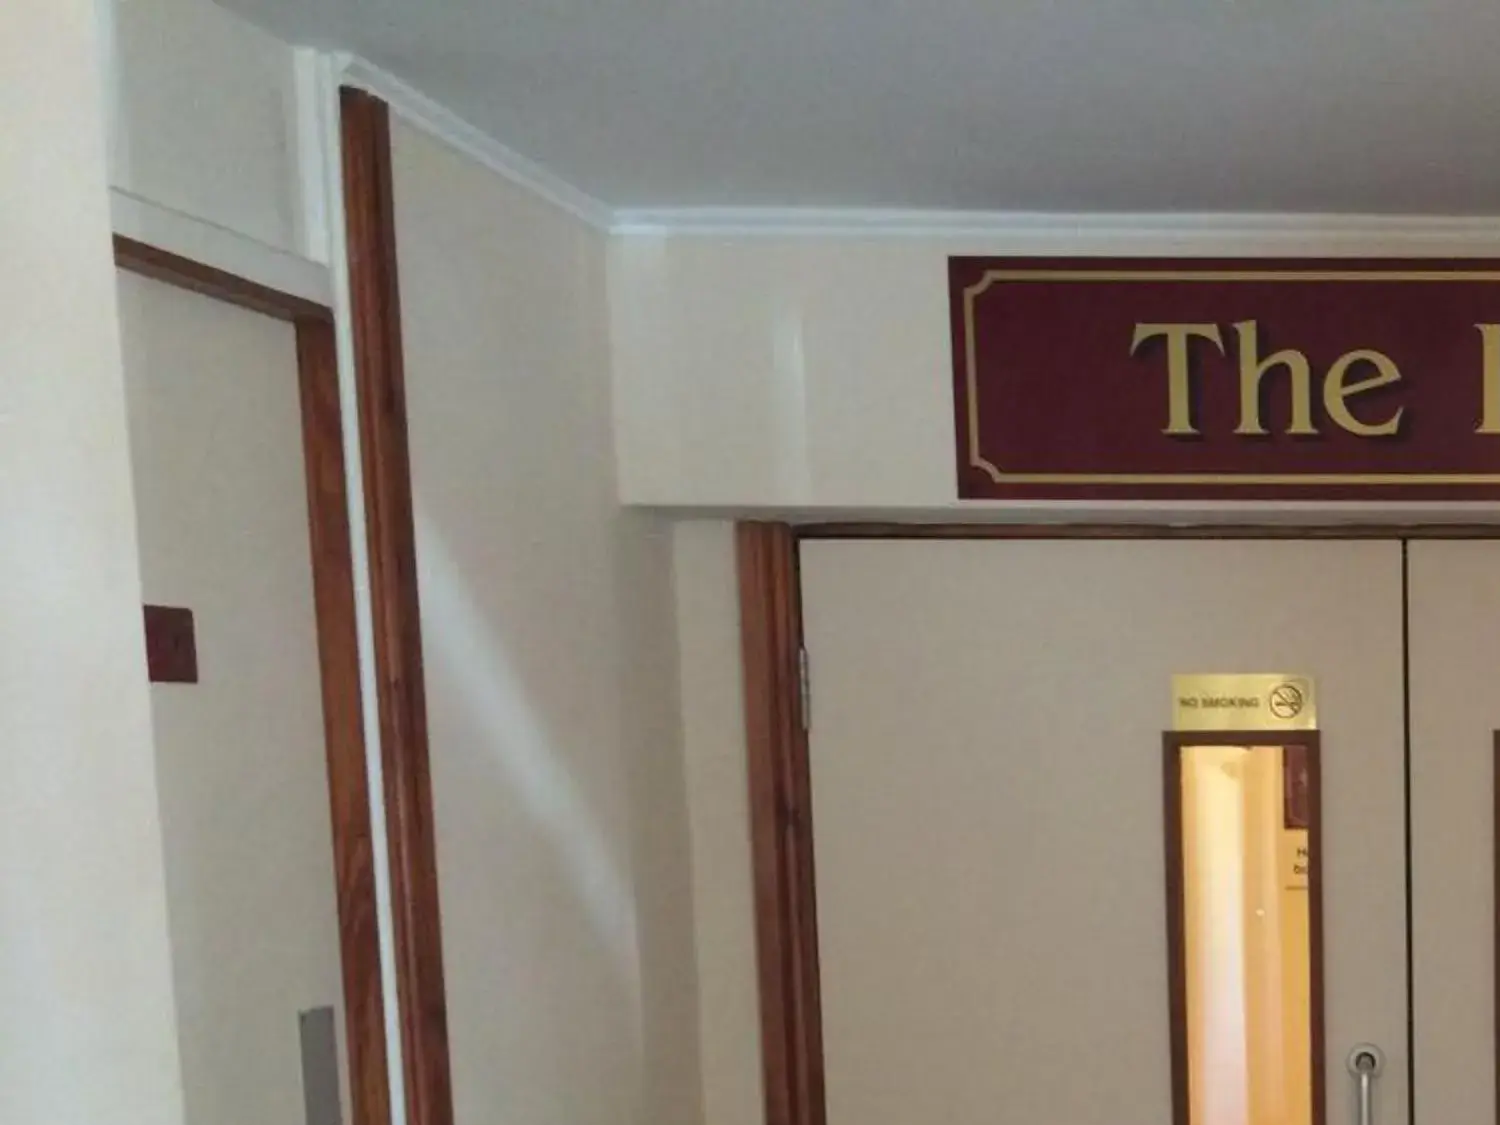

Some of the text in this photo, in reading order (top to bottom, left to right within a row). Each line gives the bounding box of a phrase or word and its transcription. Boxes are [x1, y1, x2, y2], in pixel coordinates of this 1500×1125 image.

[1130, 318, 1404, 438] The
[1178, 697, 1260, 708] NO SMOKING
